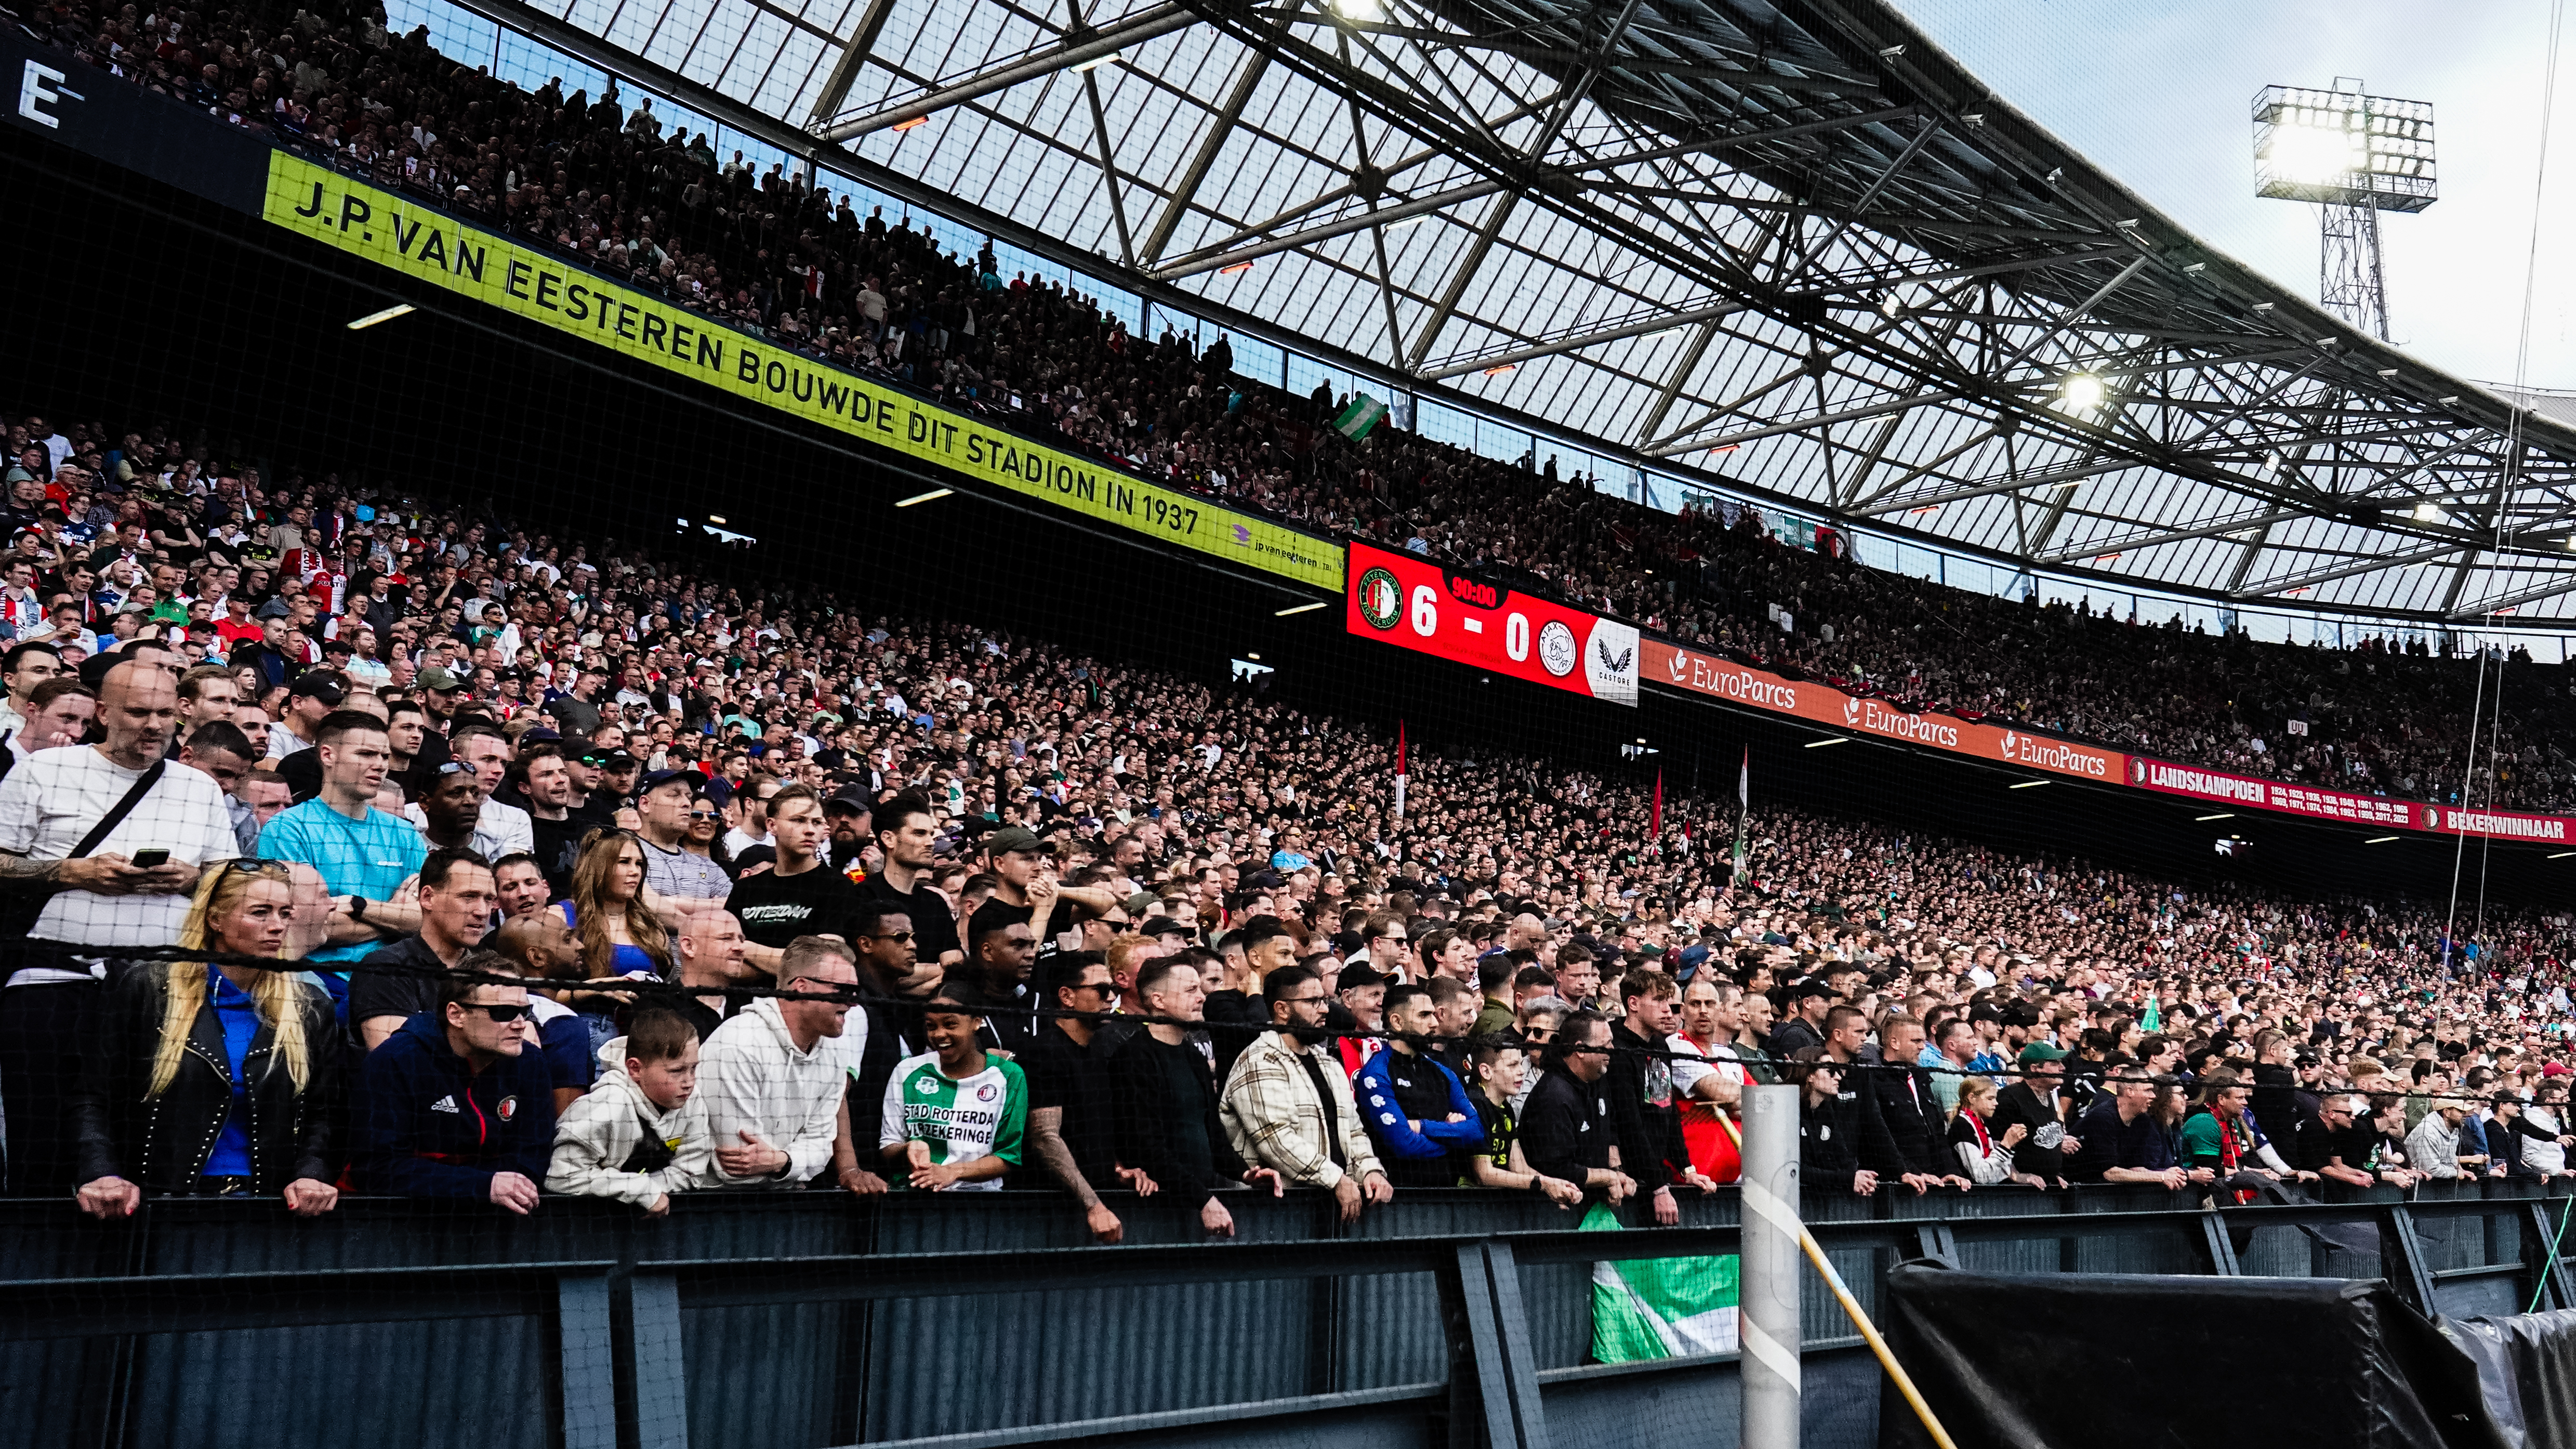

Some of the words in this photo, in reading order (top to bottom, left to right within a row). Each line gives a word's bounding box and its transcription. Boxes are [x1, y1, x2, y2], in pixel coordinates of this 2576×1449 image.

[294, 181, 373, 242] J.P.
[392, 212, 485, 284] VAN
[508, 258, 722, 373] EESTEREN
[738, 349, 895, 434] BOUWDE
[910, 410, 958, 454] DIT
[967, 434, 1095, 503] STADION
[1107, 481, 1134, 516] IN
[1143, 495, 1198, 535] 1937
[66, 531, 85, 541] Euro
[1255, 539, 1263, 551] jp
[1265, 544, 1280, 556] van
[1452, 576, 1496, 607] 90:00
[1411, 585, 1437, 637] 6
[1506, 612, 1529, 662] 0
[1541, 623, 1558, 643] AJAX
[1599, 671, 1630, 686] CASTORE
[1692, 657, 1795, 709] EuroParcs
[1866, 702, 1958, 747] EuroParcs
[2020, 737, 2105, 776] EuroParcs
[2150, 764, 2265, 803] LANDSKAMPIOEN
[2271, 786, 2288, 798] 1924,
[2393, 804, 2408, 813] 1965
[2289, 799, 2305, 811] 1971,
[2306, 802, 2322, 813] 1974,
[2375, 812, 2392, 823] 2017,
[2393, 814, 2408, 824] 2023
[2447, 811, 2564, 839] BEKERWINNAAR
[431, 1104, 459, 1113] adidas
[905, 1105, 929, 1118] STAD
[933, 1108, 994, 1126] ROTTERDA
[908, 1123, 992, 1144] VERZEKERINGE
